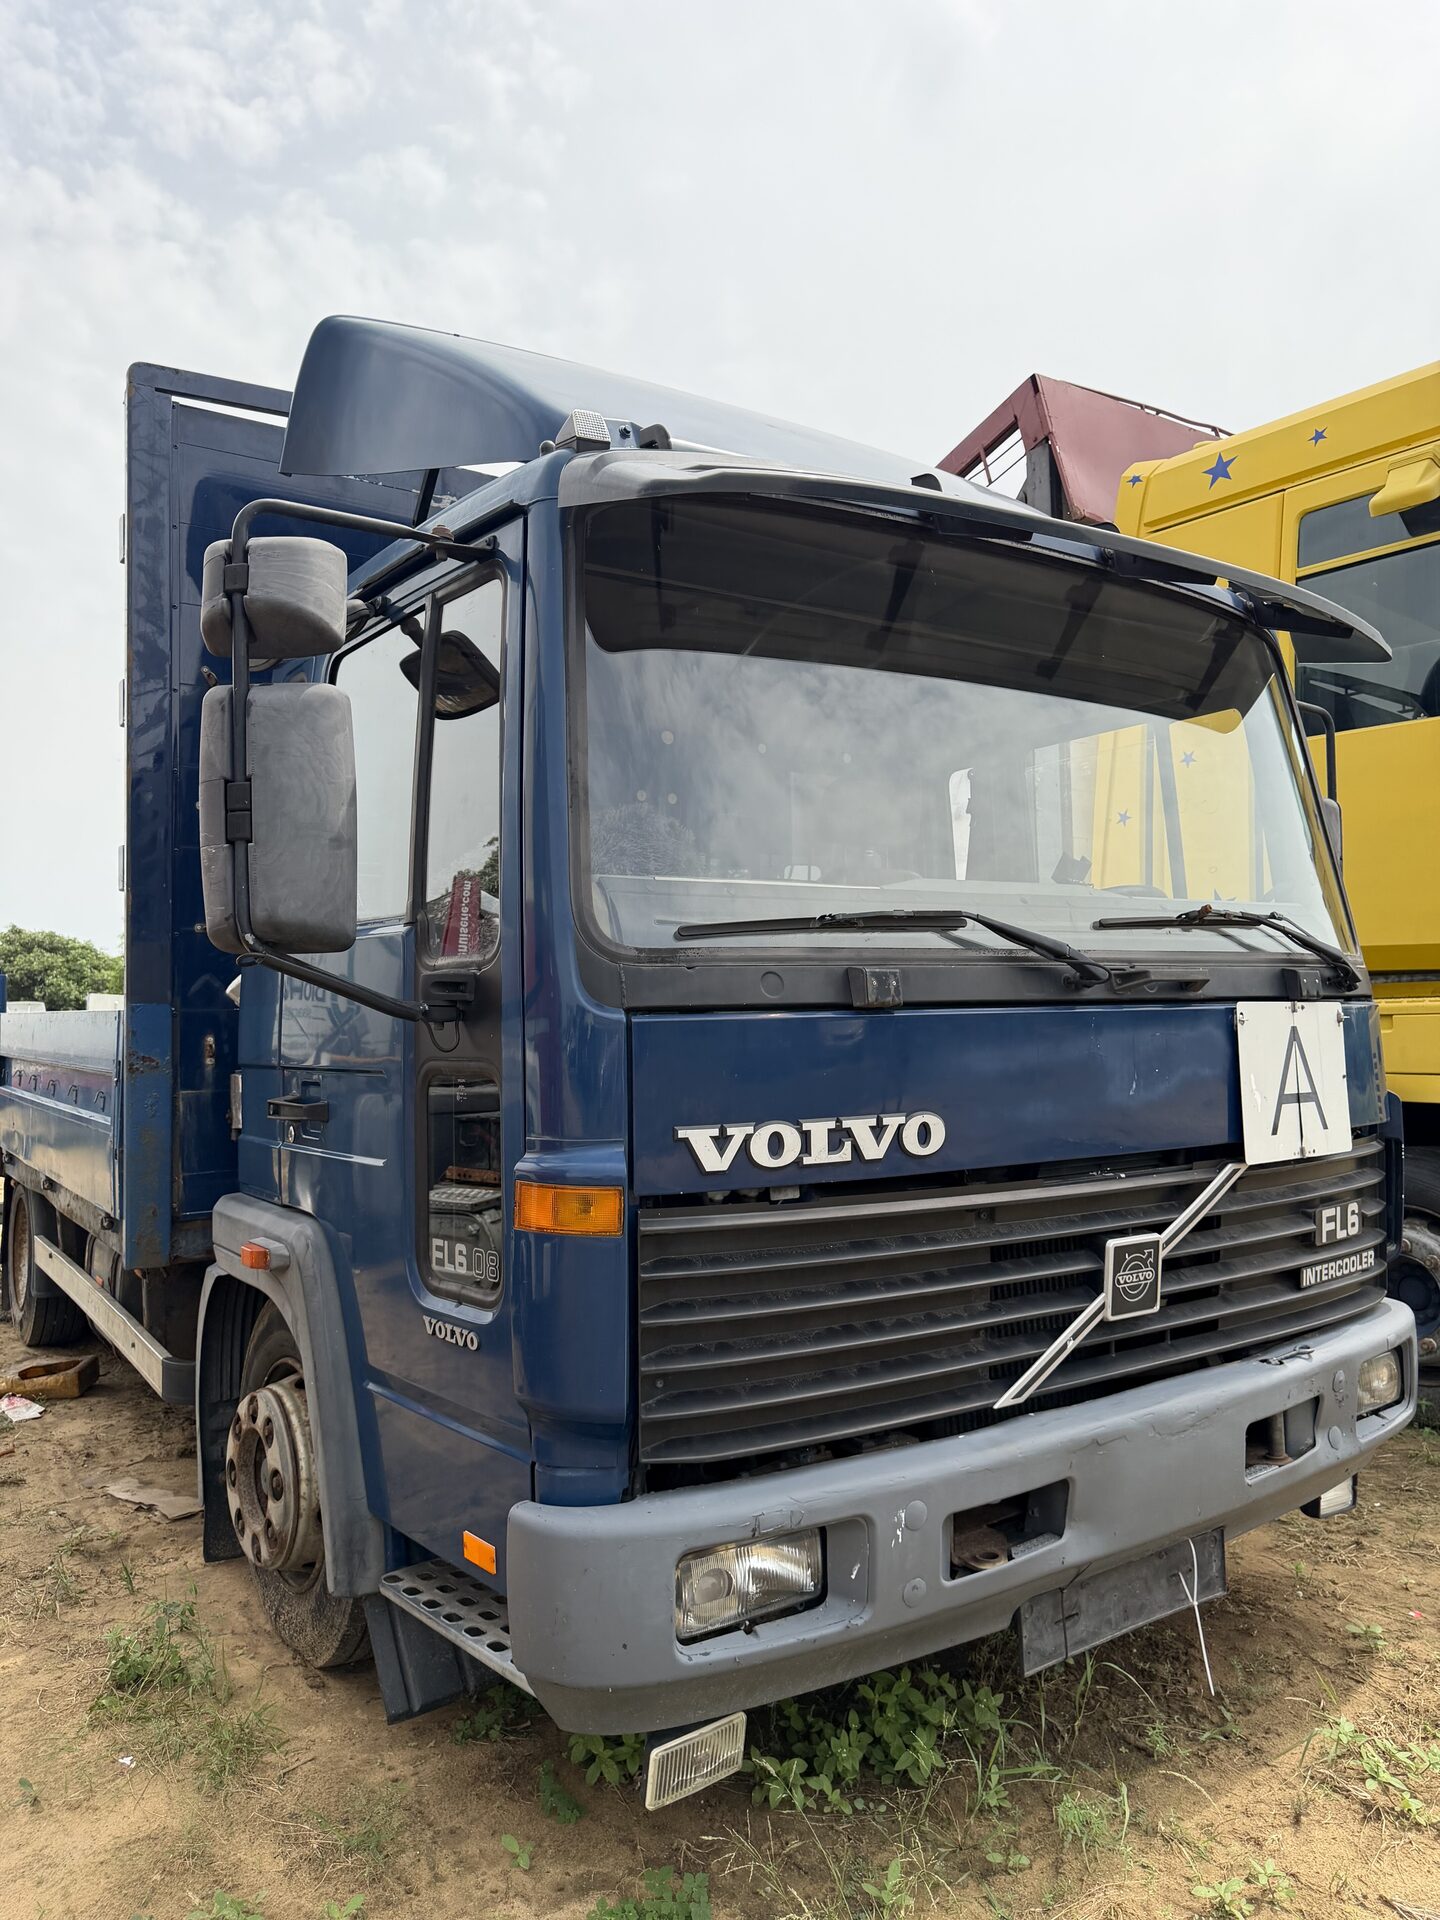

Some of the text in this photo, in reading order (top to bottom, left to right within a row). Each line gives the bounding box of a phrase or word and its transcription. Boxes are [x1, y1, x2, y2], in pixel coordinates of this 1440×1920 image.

[1271, 1026, 1329, 1136] A
[674, 1111, 946, 1173] VOLVO
[1321, 1202, 1359, 1243] FL6
[432, 1238, 499, 1282] FL6 08
[1118, 1271, 1153, 1284] VOLVO
[1302, 1250, 1375, 1288] INTERCOOLER
[423, 1315, 479, 1351] VOLVO
